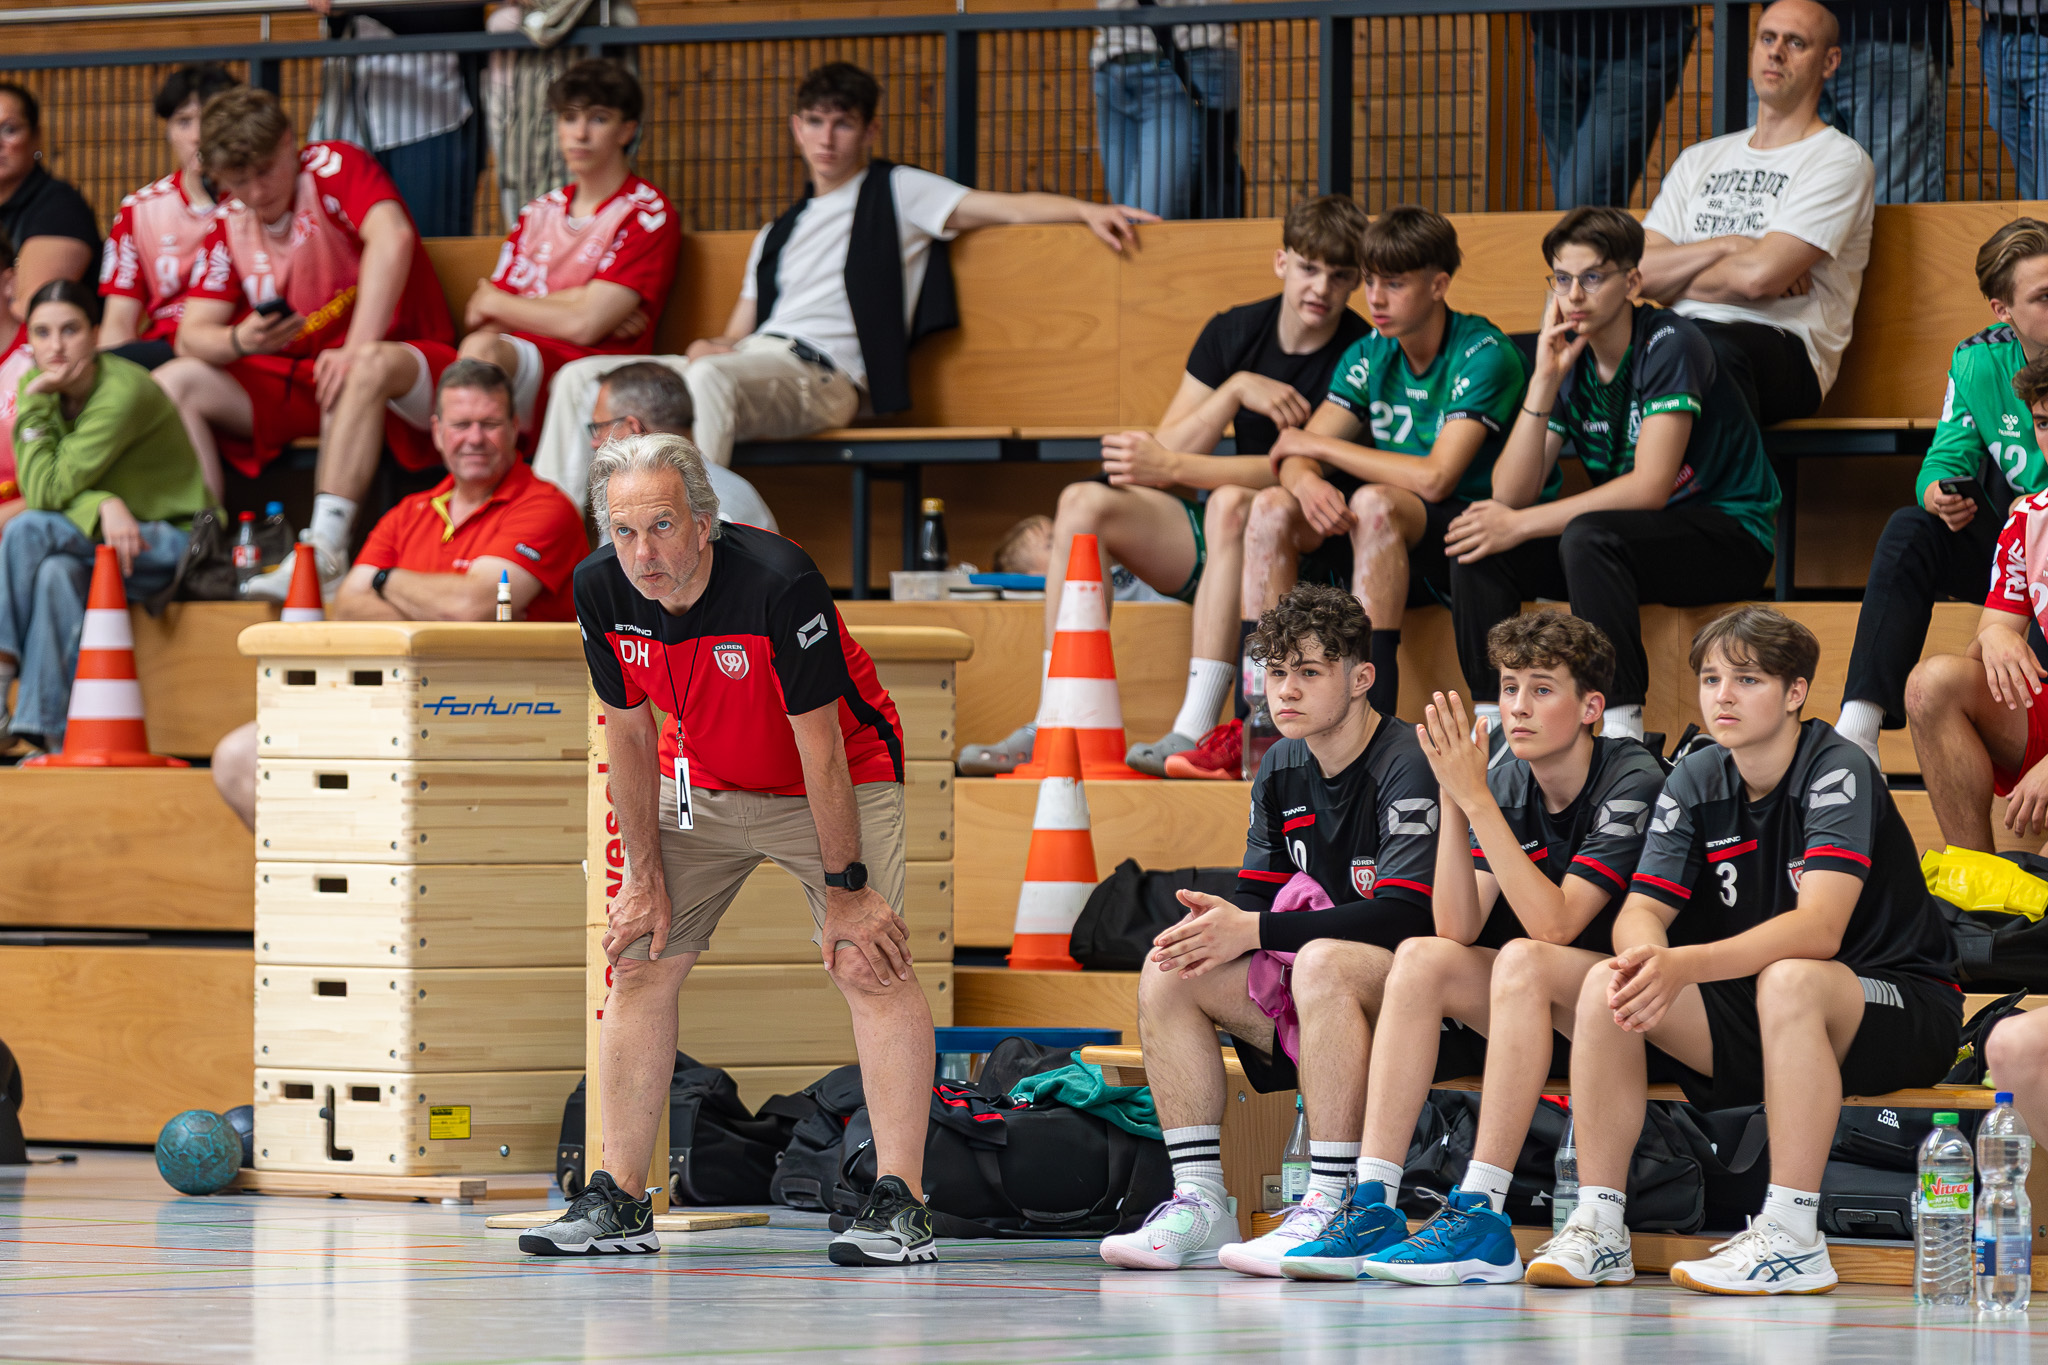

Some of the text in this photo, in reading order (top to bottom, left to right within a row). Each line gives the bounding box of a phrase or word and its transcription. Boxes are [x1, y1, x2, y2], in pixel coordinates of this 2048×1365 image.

[1369, 400, 1414, 444] 27
[614, 623, 653, 637] STANNO
[619, 639, 650, 668] DH
[721, 652, 743, 672] 99
[422, 695, 562, 716] fortuna
[1282, 805, 1307, 817] TANNO
[1355, 868, 1376, 891] 99
[1715, 861, 1738, 908] 3
[1877, 1113, 1900, 1130] LODA
[1930, 1176, 1970, 1196] Vitrex
